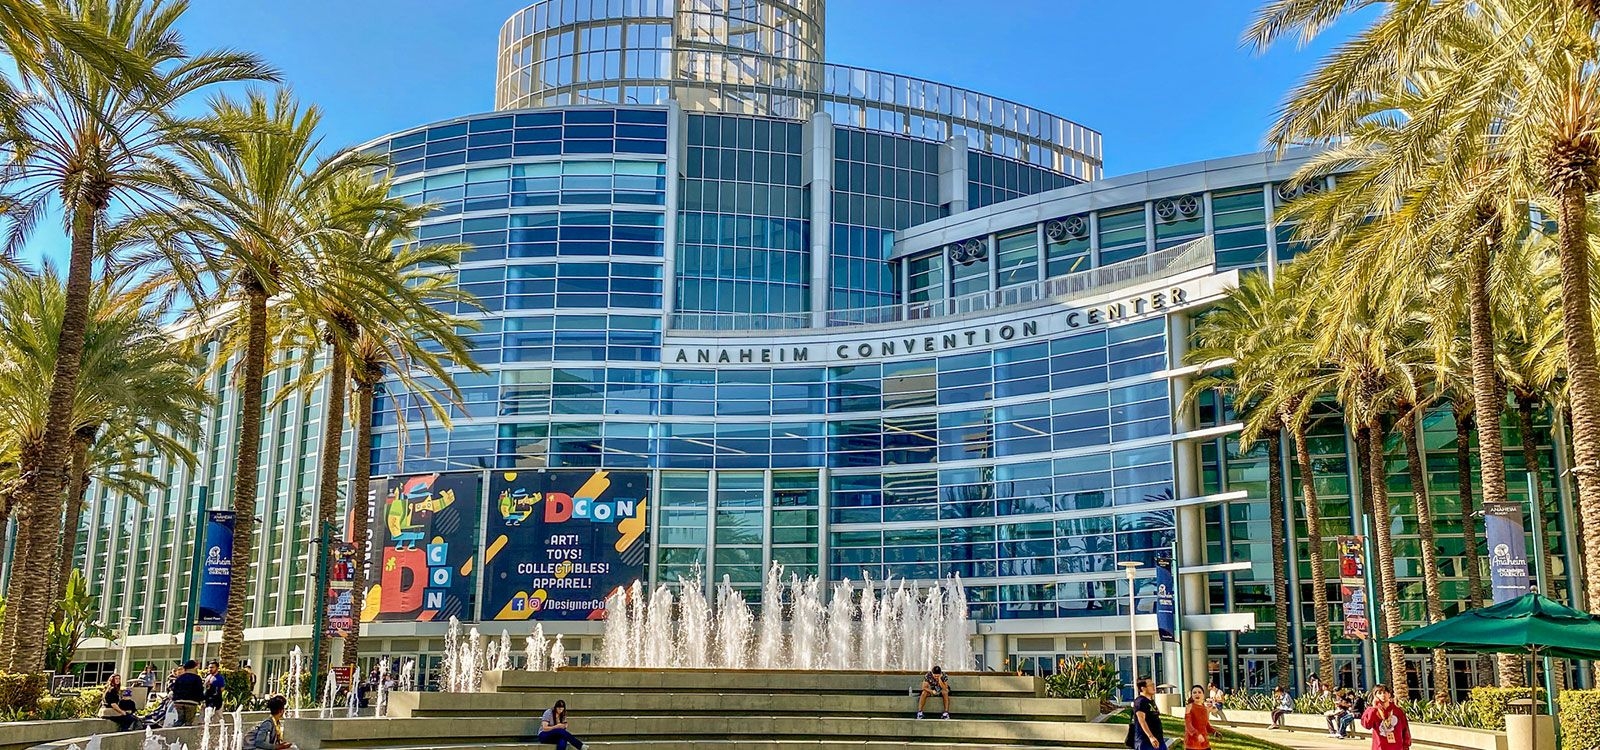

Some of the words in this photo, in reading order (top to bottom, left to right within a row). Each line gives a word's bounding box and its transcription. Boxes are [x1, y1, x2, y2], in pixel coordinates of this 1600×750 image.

[676, 347, 808, 363] ANAHEIM
[836, 320, 1037, 359] CONVENTION
[1066, 287, 1185, 328] CENTER
[544, 492, 633, 523] DCON
[550, 534, 579, 546] ART!
[546, 549, 582, 560] TOYS!
[1492, 553, 1526, 567] Anaheim
[518, 563, 609, 574] COLLECTIBLES!
[533, 578, 592, 589] APPAREL!
[543, 599, 605, 611] /DesignerCo
